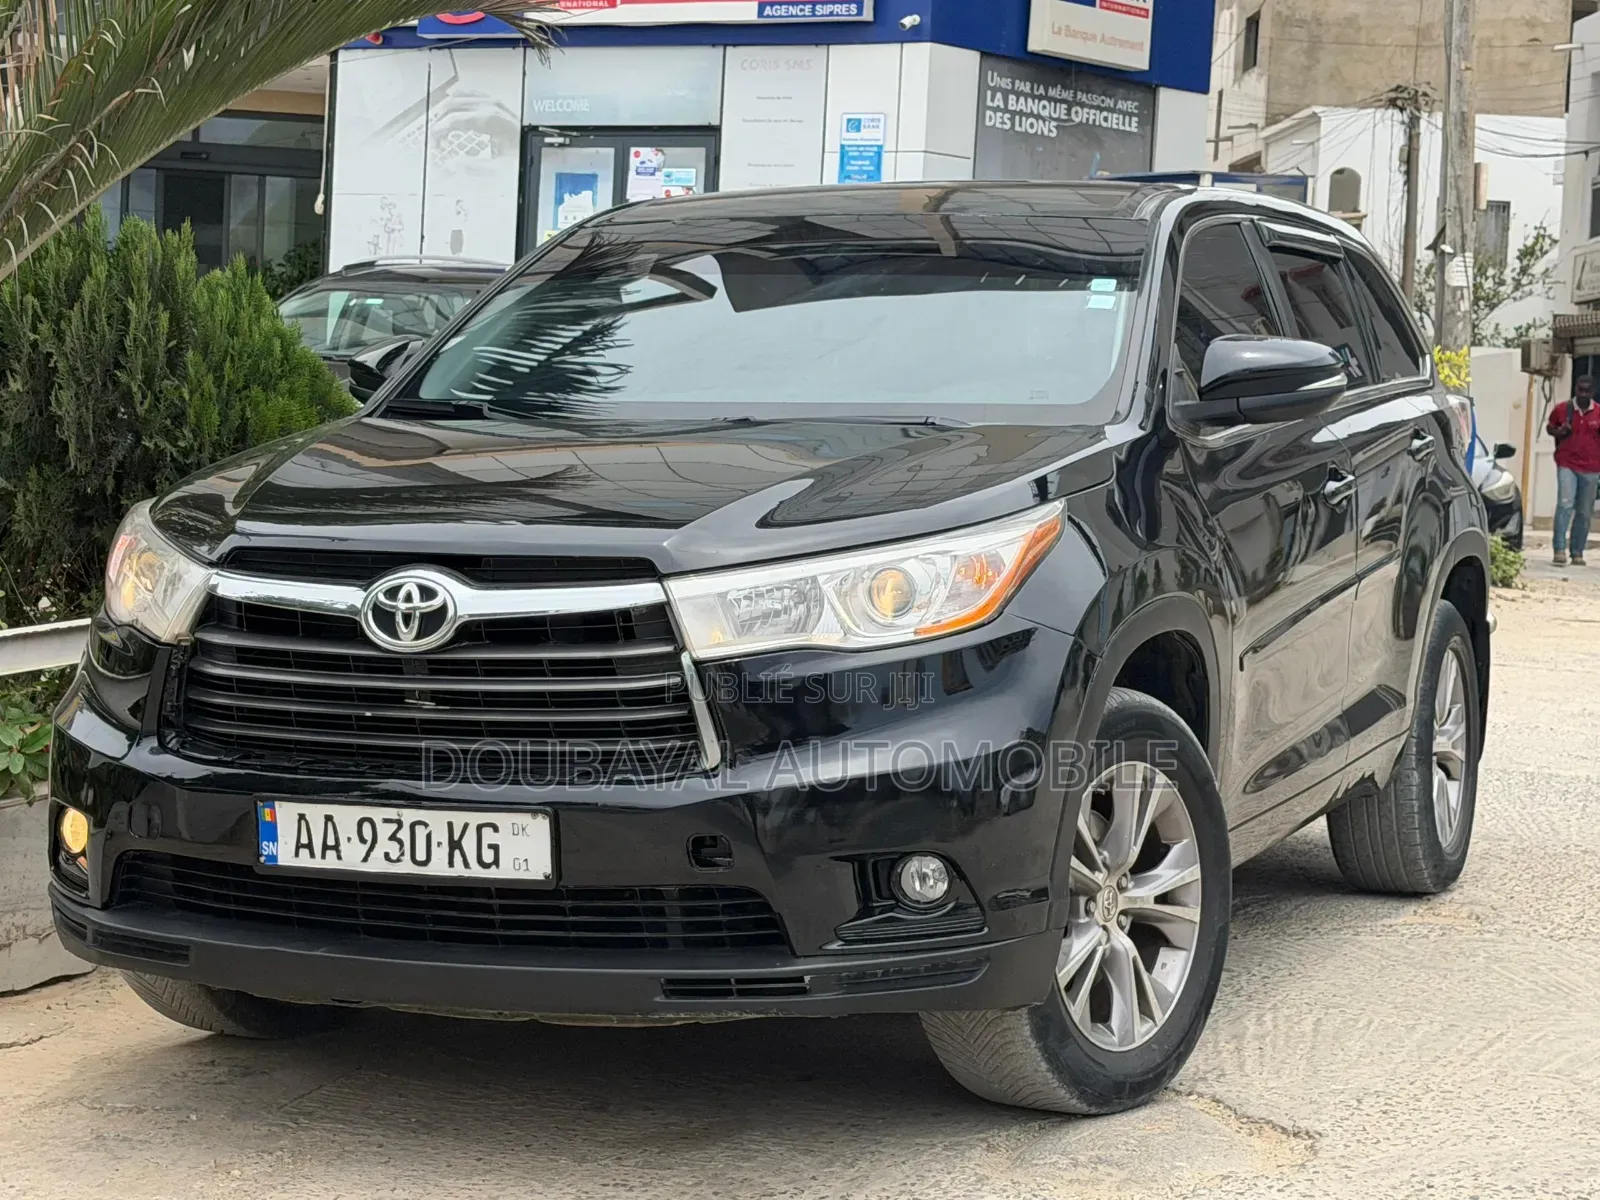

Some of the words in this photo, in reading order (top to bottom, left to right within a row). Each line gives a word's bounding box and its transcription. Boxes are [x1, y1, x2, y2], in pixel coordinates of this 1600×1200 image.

[763, 5, 813, 17] AGENCE
[814, 4, 858, 16] SIPRES
[1051, 21, 1062, 36] La
[1064, 24, 1098, 44] Banque
[533, 96, 590, 113] WELCOME
[1014, 79, 1031, 93] PAR
[1034, 83, 1045, 96] LA
[1047, 84, 1075, 101] MÊME
[1076, 91, 1115, 108] PASSION
[1116, 99, 1140, 114] AVEC
[986, 90, 1005, 109] LA
[1007, 94, 1069, 120] BANQUE
[1071, 106, 1140, 133] OFFICIELLE
[985, 110, 1012, 131] DES
[1014, 115, 1059, 138] LIONS
[511, 822, 530, 837] DK
[261, 841, 278, 856] SN
